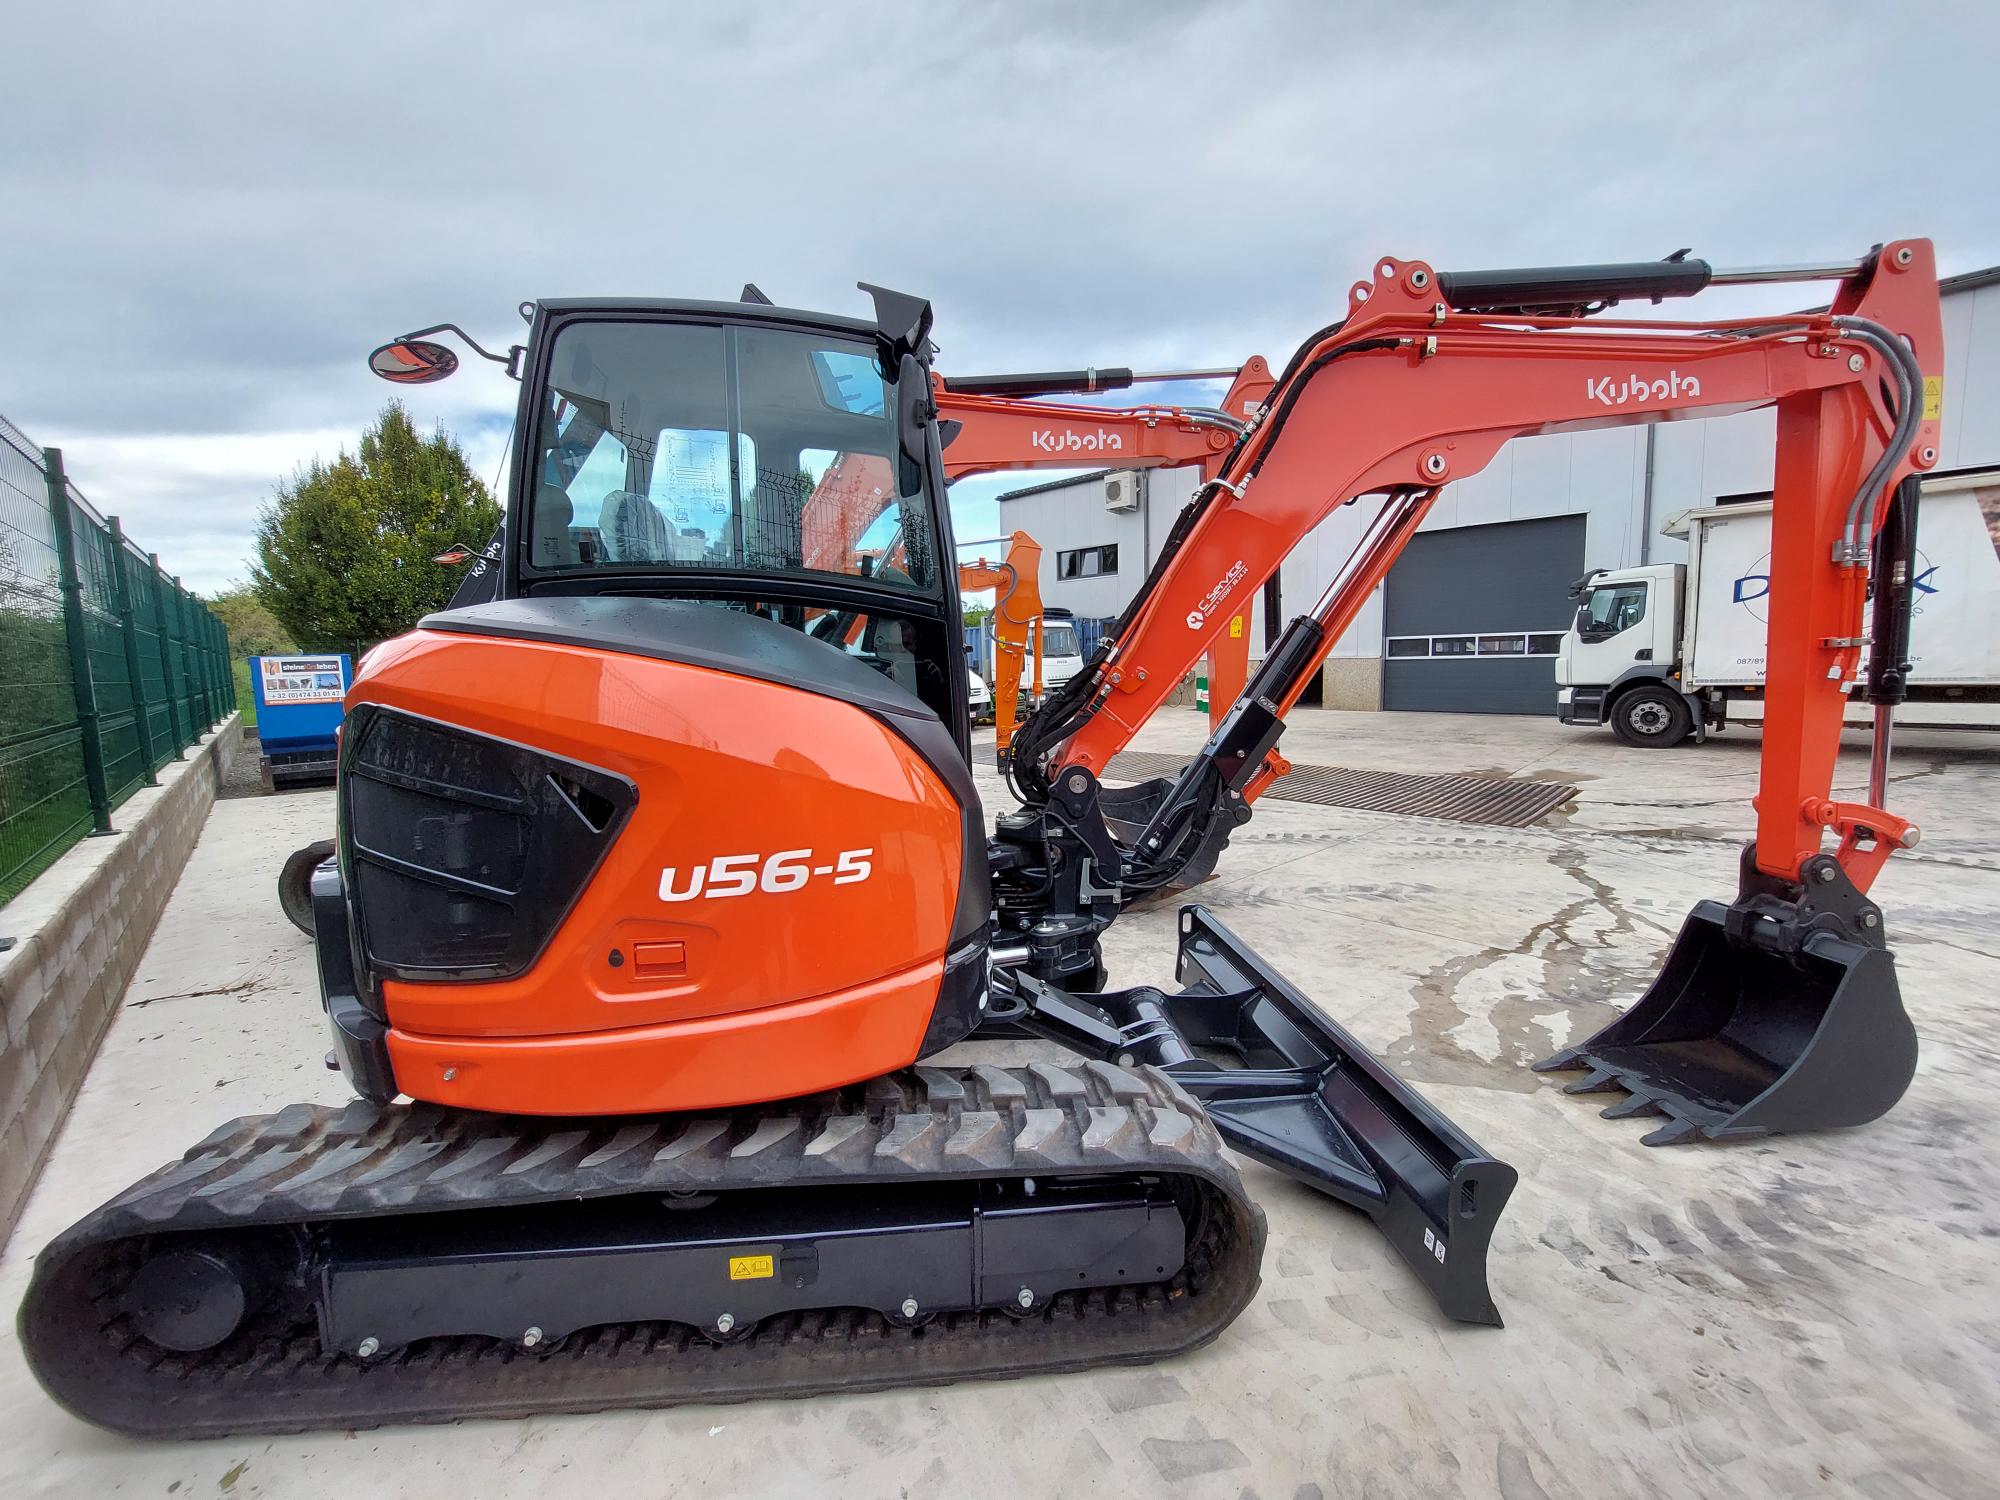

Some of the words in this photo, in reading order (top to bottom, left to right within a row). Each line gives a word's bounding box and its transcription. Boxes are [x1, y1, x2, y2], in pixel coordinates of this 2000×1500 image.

[1587, 370, 1700, 406] Kubota
[1032, 428, 1122, 452] Kubota
[1206, 560, 1242, 601] Service
[658, 848, 874, 902] U56-5
